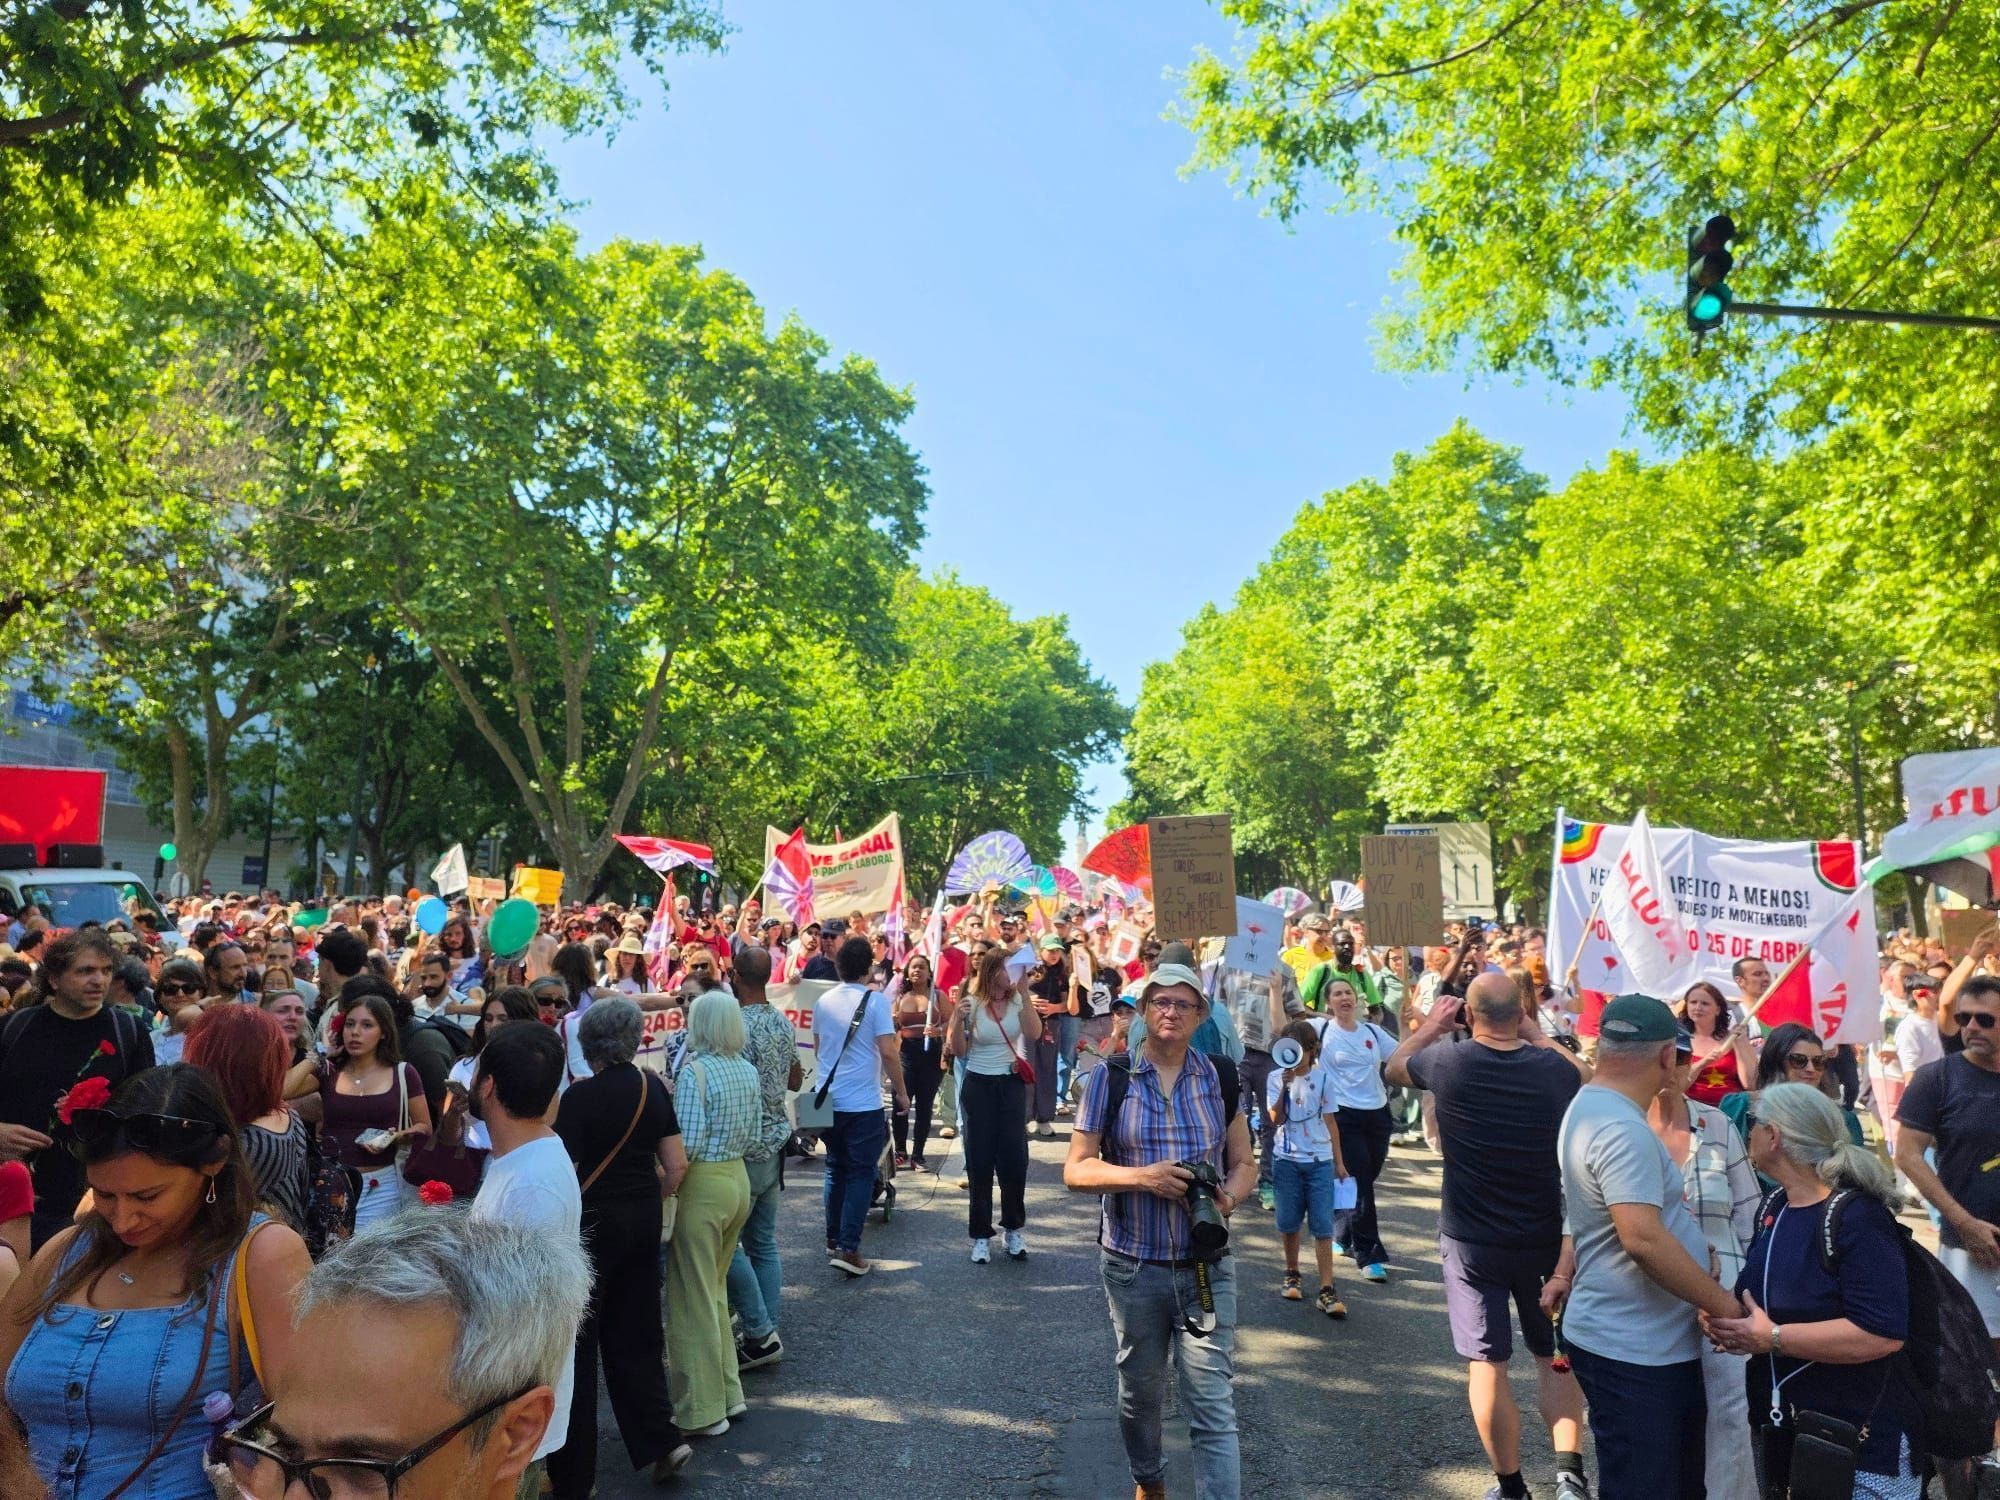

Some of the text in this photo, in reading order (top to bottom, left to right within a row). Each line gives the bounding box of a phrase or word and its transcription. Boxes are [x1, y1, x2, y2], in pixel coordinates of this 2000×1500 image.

[839, 831, 894, 862] GERAL
[856, 853, 895, 871] LABORAL
[1162, 886, 1187, 905] 25
[1728, 884, 1739, 902] A
[1743, 886, 1811, 910] MENOS!
[1163, 909, 1219, 934] SEMPRE
[1712, 905, 1725, 920] DE
[1729, 908, 1808, 929] MONTENEGRO!
[1706, 933, 1726, 955] 25
[1731, 937, 1753, 958] DE
